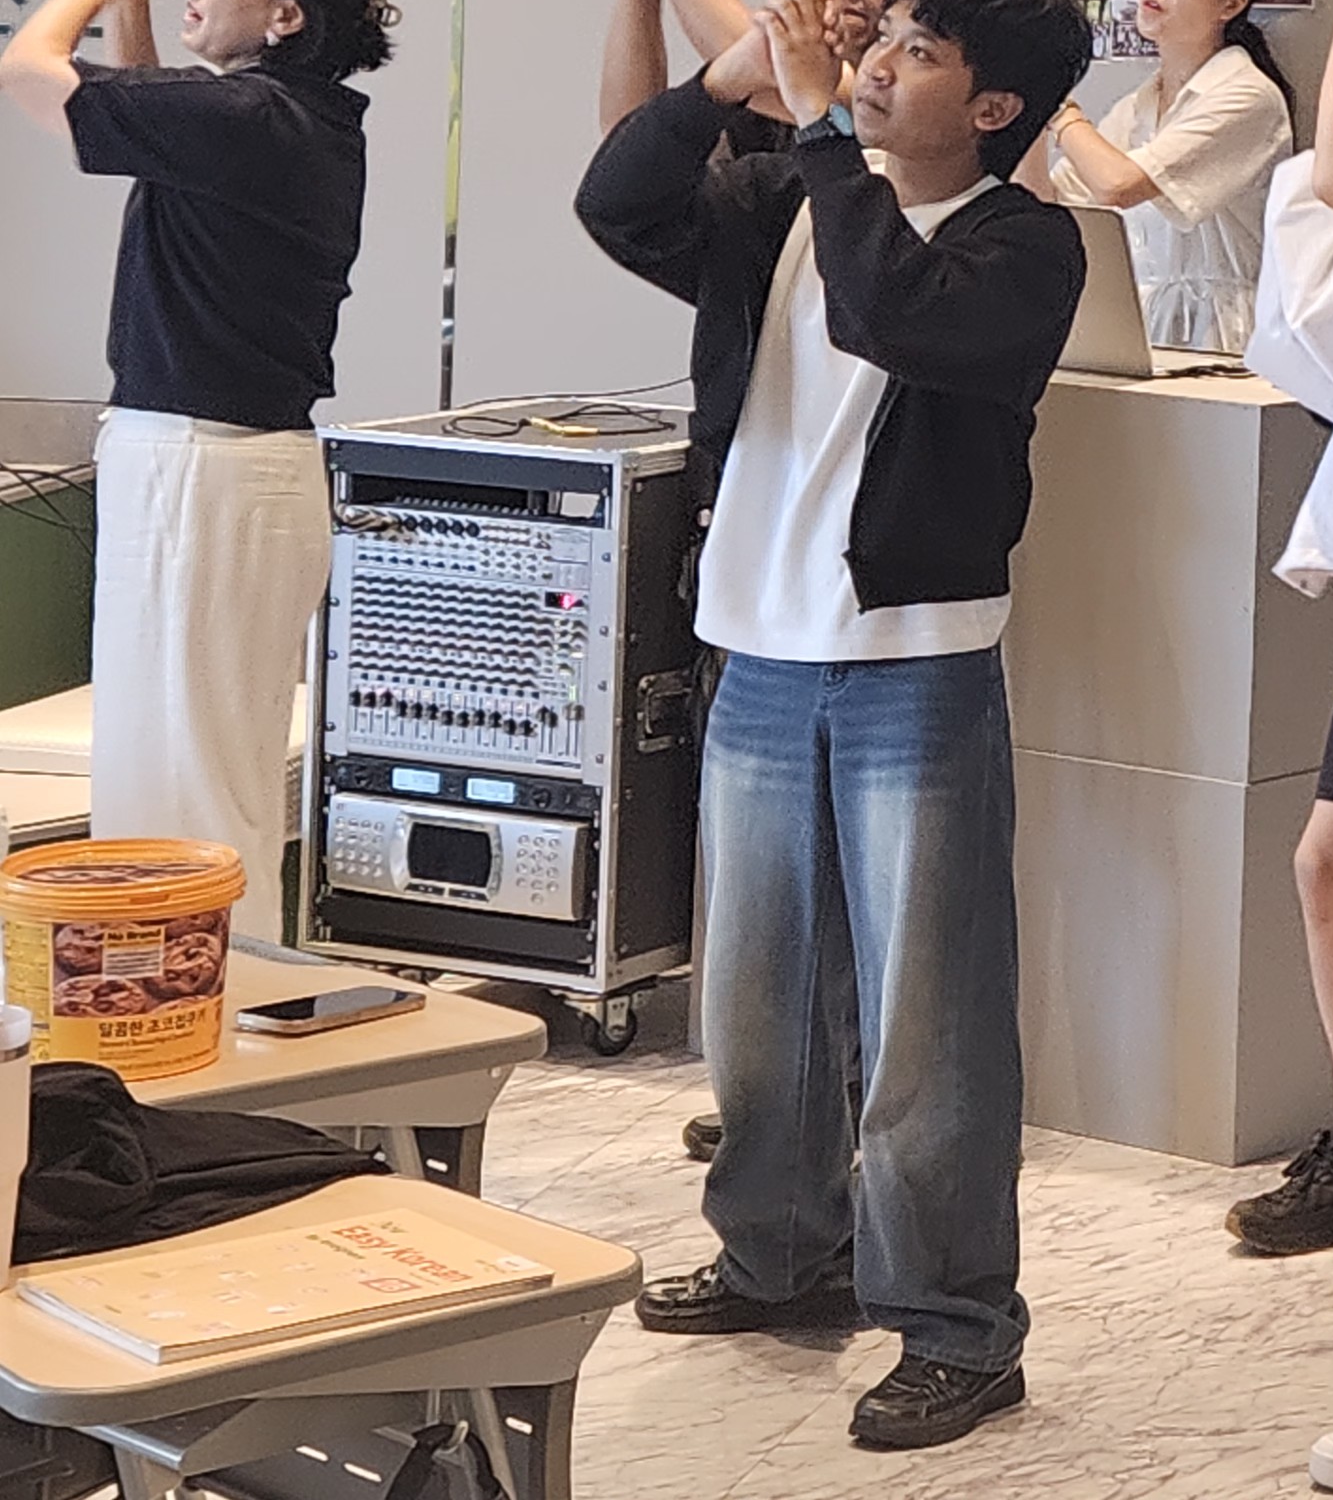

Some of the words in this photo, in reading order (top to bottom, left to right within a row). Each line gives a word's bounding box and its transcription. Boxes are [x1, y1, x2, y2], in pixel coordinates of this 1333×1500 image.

[98, 1020, 143, 1038] 달콤한
[330, 1225, 398, 1249] Easy
[381, 1247, 473, 1283] Korean
